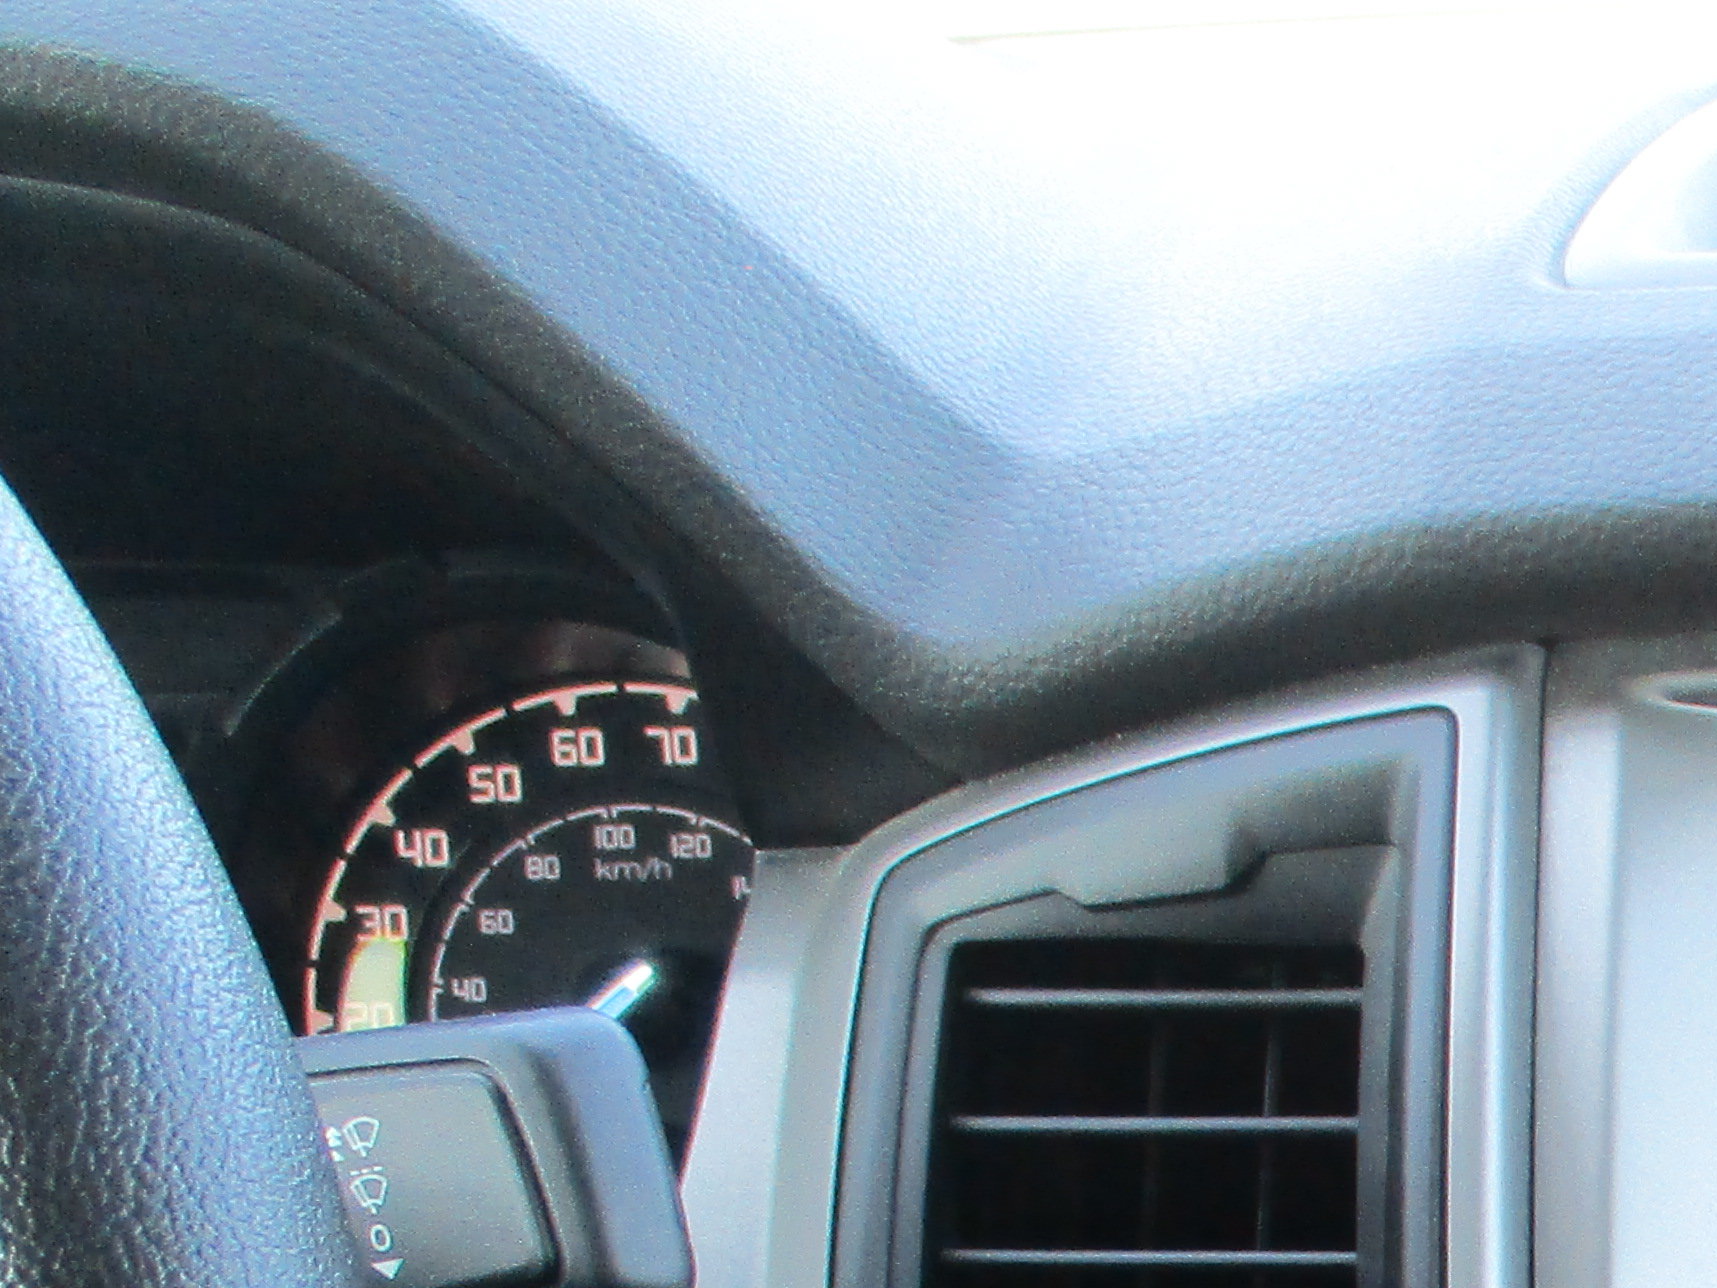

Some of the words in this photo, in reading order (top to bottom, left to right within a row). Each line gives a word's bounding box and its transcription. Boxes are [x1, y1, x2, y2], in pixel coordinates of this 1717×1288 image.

[550, 727, 605, 768] 60
[644, 725, 697, 766] 70
[467, 764, 524, 804] 50
[394, 828, 450, 868] 40
[593, 824, 636, 850] 100
[669, 832, 712, 859] 120
[524, 854, 560, 881] 80
[594, 858, 672, 882] km/h
[355, 904, 408, 941] 30
[478, 908, 514, 936] 60
[451, 976, 487, 1004] 40
